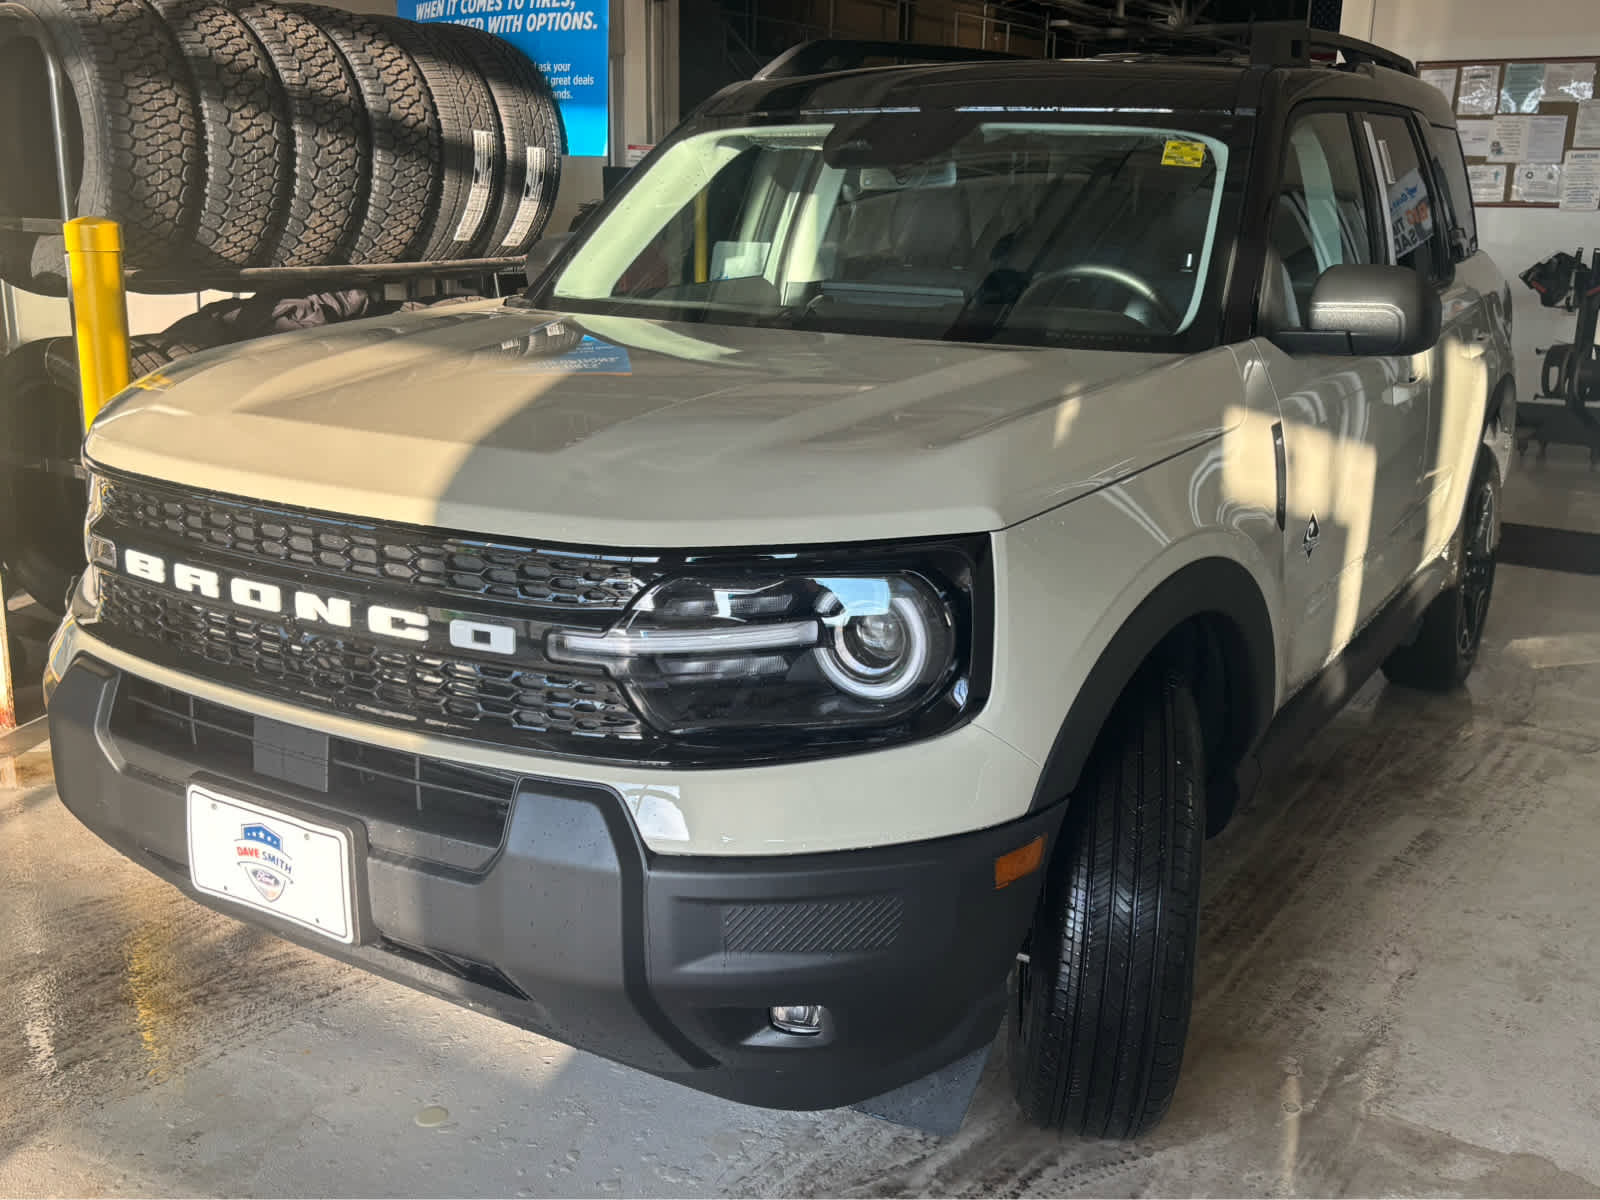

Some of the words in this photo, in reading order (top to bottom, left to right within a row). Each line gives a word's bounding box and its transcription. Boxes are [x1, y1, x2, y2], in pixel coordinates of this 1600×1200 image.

[416, 0, 445, 21] WHEN
[446, 0, 458, 16] IT
[461, 0, 503, 14] COMES
[507, 0, 525, 10] TO
[488, 14, 524, 34] WITH
[526, 11, 598, 32] OPTIONS.
[538, 61, 551, 72] ask
[553, 63, 571, 75] your
[551, 75, 571, 88] great
[573, 74, 594, 86] deals
[125, 549, 516, 655] BRONCO
[236, 845, 260, 858] DAVE
[262, 851, 292, 875] SMITH
